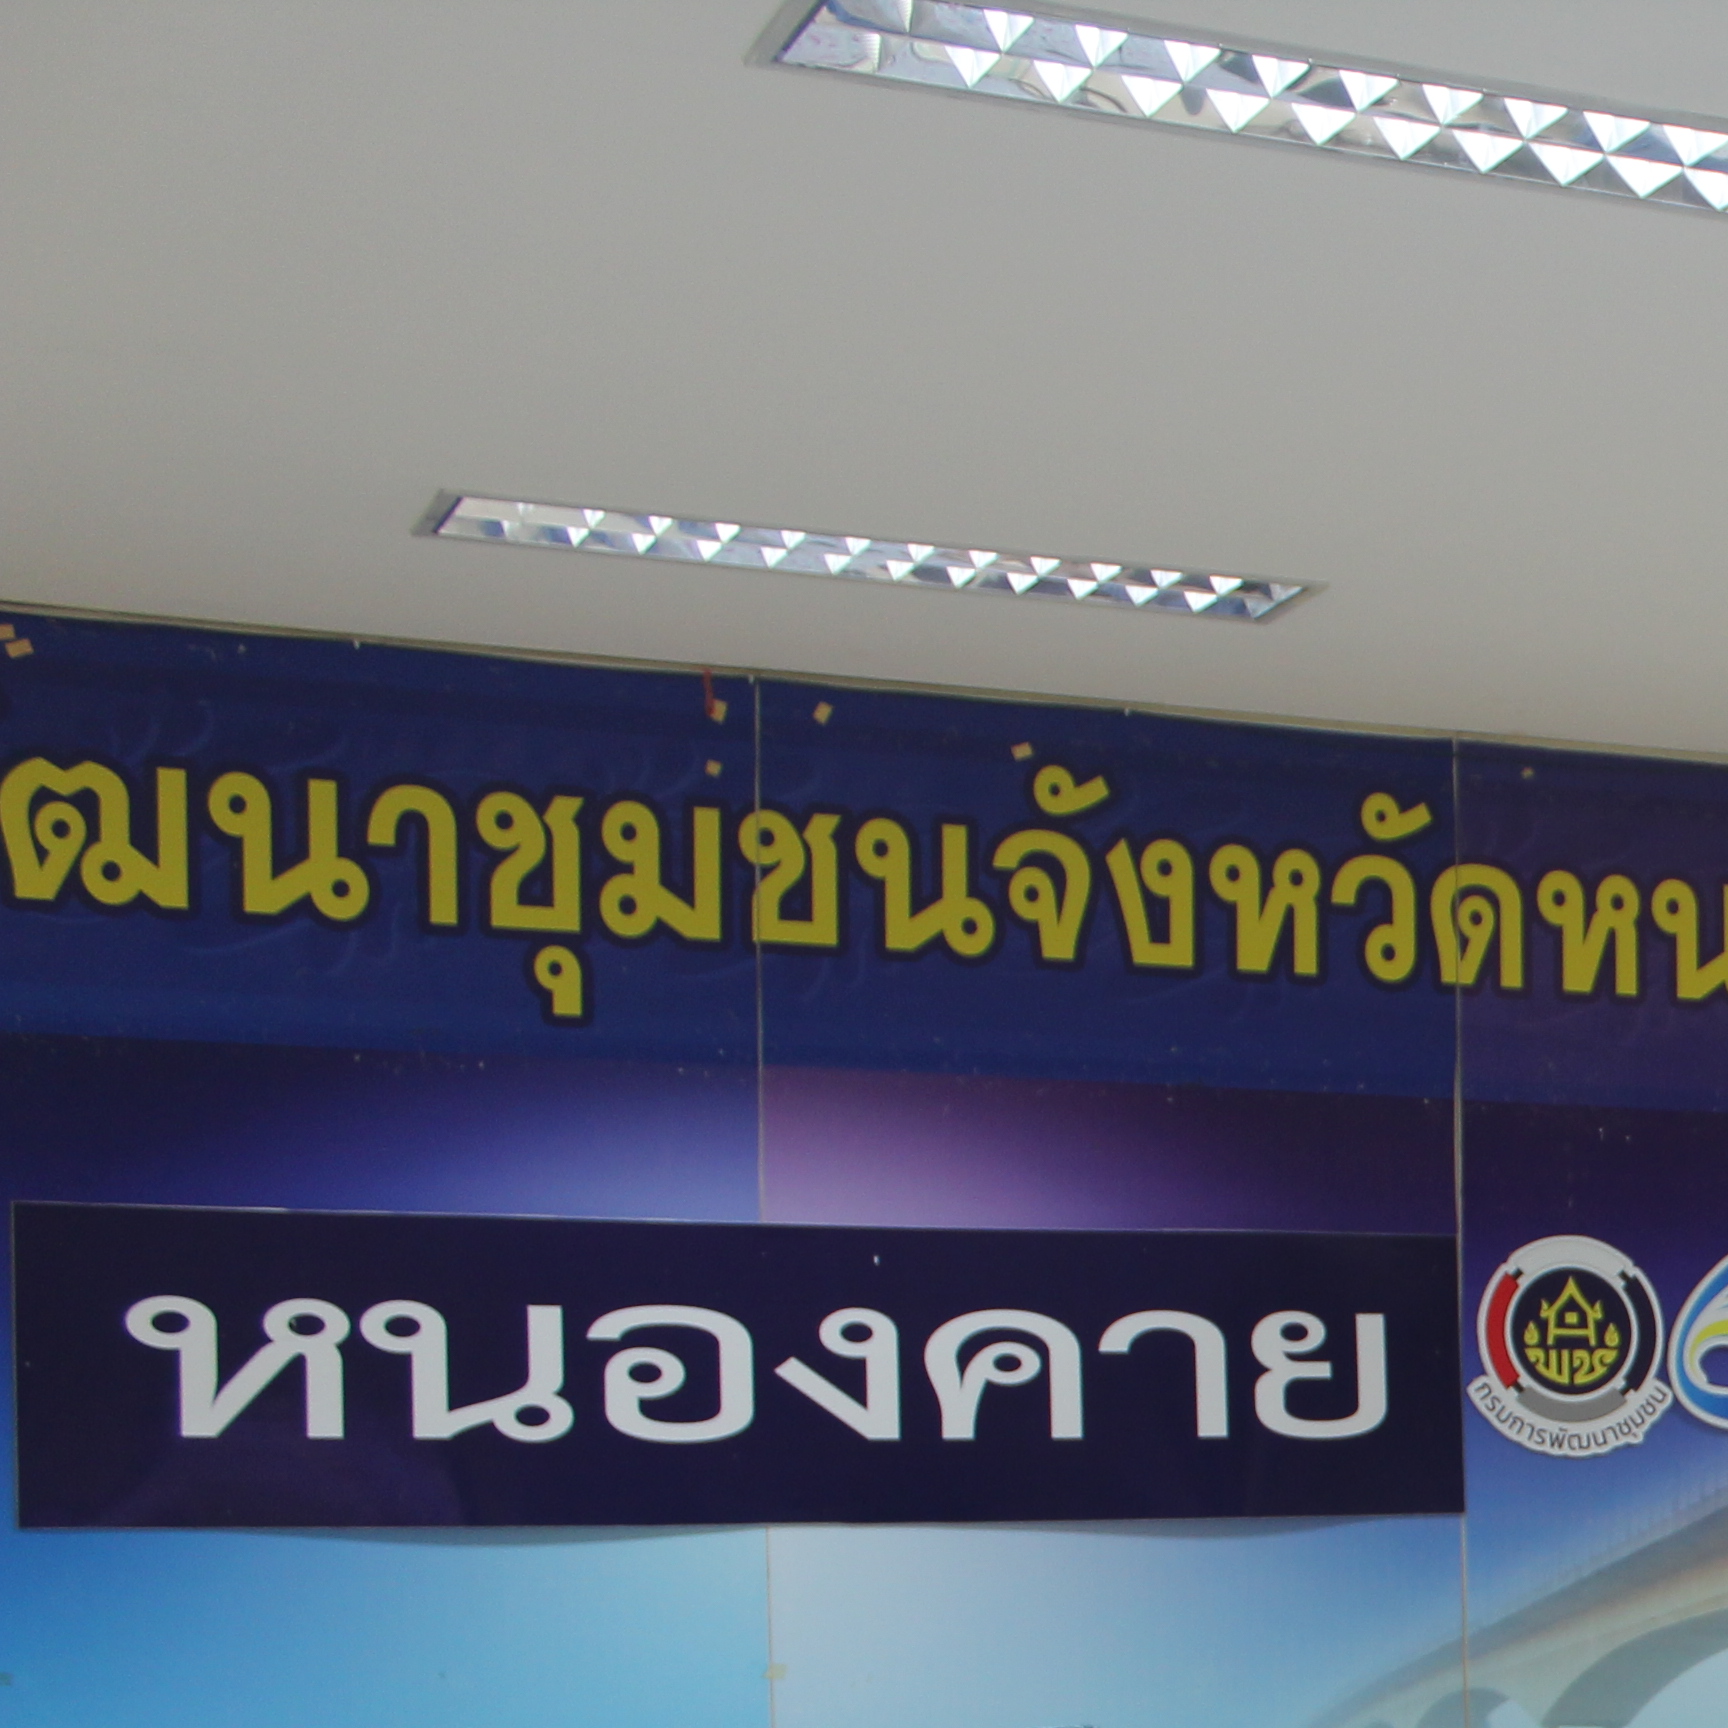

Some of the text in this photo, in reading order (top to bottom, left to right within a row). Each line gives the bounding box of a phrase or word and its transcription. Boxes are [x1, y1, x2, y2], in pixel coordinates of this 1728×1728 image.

[124, 1294, 1387, 1444] หนองคาย
[1474, 1382, 1668, 1451] กรมการพัฒนาชุมชน
